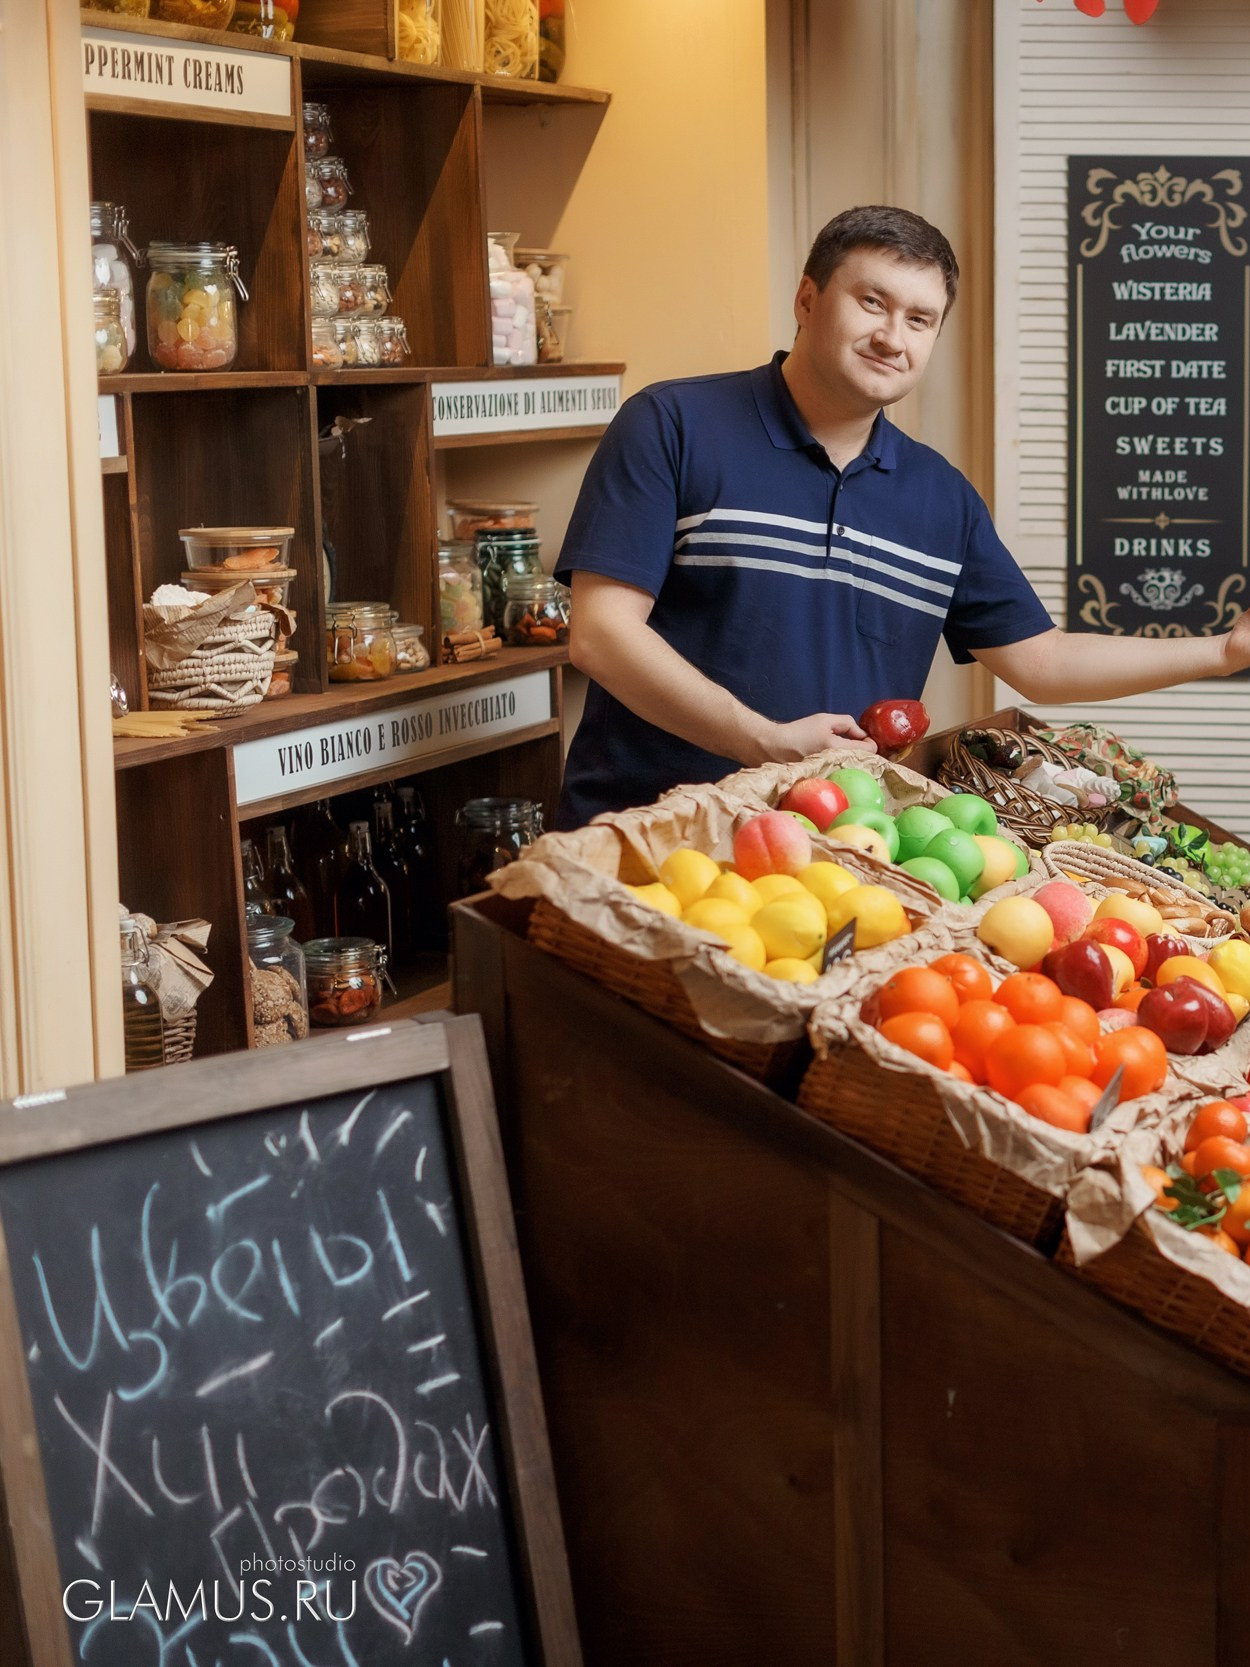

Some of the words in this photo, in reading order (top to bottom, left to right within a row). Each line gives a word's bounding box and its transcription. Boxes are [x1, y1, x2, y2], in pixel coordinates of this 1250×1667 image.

[84, 43, 174, 86] PPERMINT
[183, 57, 244, 95] CREAMS
[1131, 222, 1202, 241] Your
[1120, 243, 1213, 264] flowers
[1111, 279, 1213, 301] WISTERIA
[1109, 320, 1219, 341] LAVENDER
[1105, 359, 1165, 378] FIRST
[1170, 360, 1227, 379] DATE
[524, 391, 536, 415] DI
[540, 387, 588, 414] ALIMENTI
[1105, 396, 1147, 415] CUP
[1151, 397, 1180, 415] OF
[1184, 397, 1227, 416] TEA
[1116, 434, 1224, 456] SWEETS
[1138, 470, 1188, 484] MADE
[1116, 485, 1209, 501] WITHLOVE
[1114, 538, 1212, 557] DRINKS
[278, 743, 314, 777] VINO
[320, 726, 372, 767] BIANCO
[378, 723, 387, 751] E
[391, 711, 433, 748] ROSSO
[439, 690, 517, 735] INVECCHIATO
